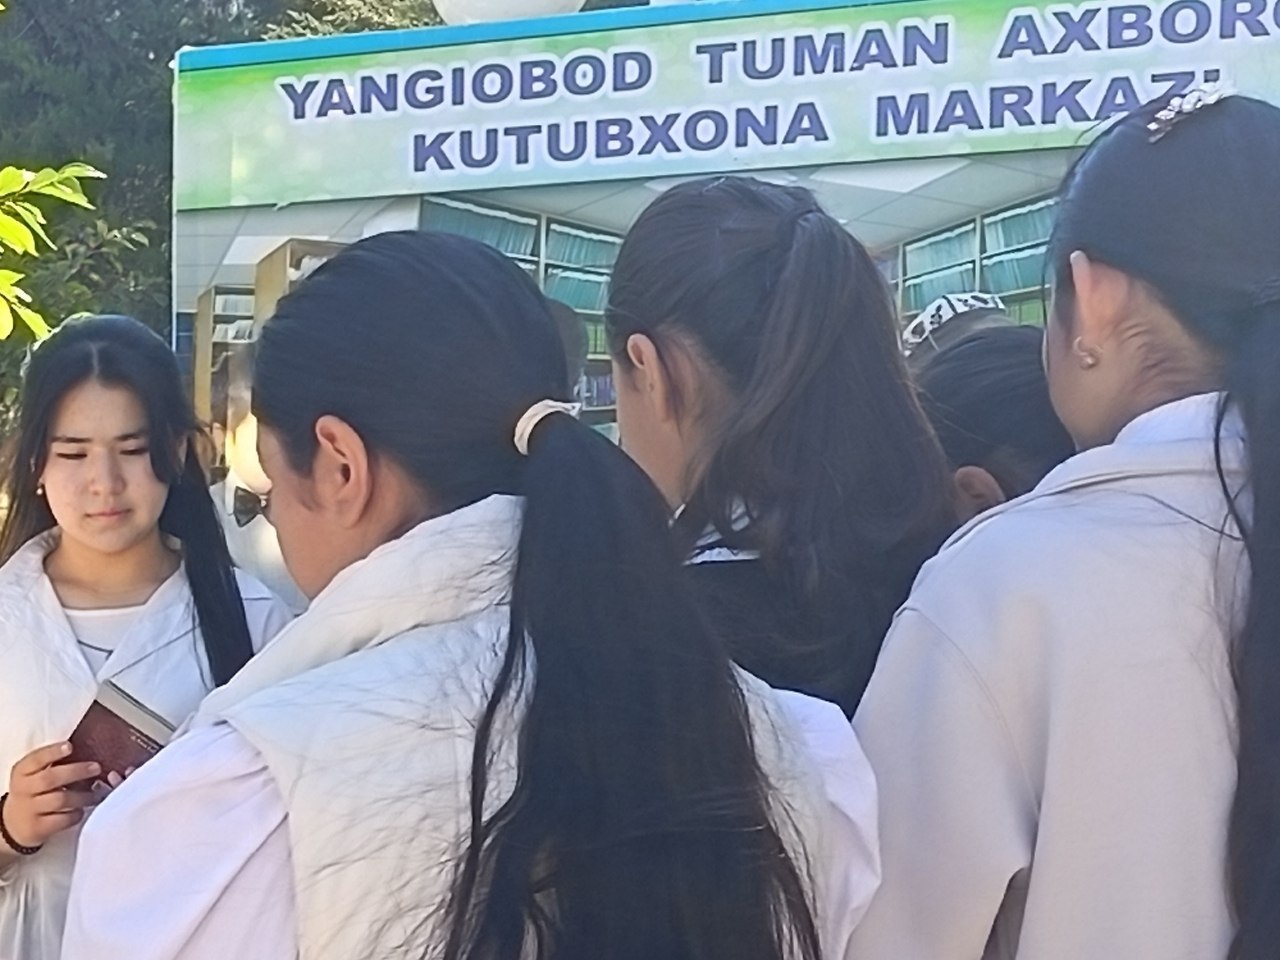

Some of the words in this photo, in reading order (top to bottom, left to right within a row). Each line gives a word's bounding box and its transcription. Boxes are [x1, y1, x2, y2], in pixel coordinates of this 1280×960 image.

[280, 51, 653, 120] YANGIOBOD
[695, 22, 949, 84] TUMAN
[996, 0, 1280, 59] AXBOR
[413, 102, 829, 172] KUTUBXONA
[875, 68, 1220, 138] MARKAZ
